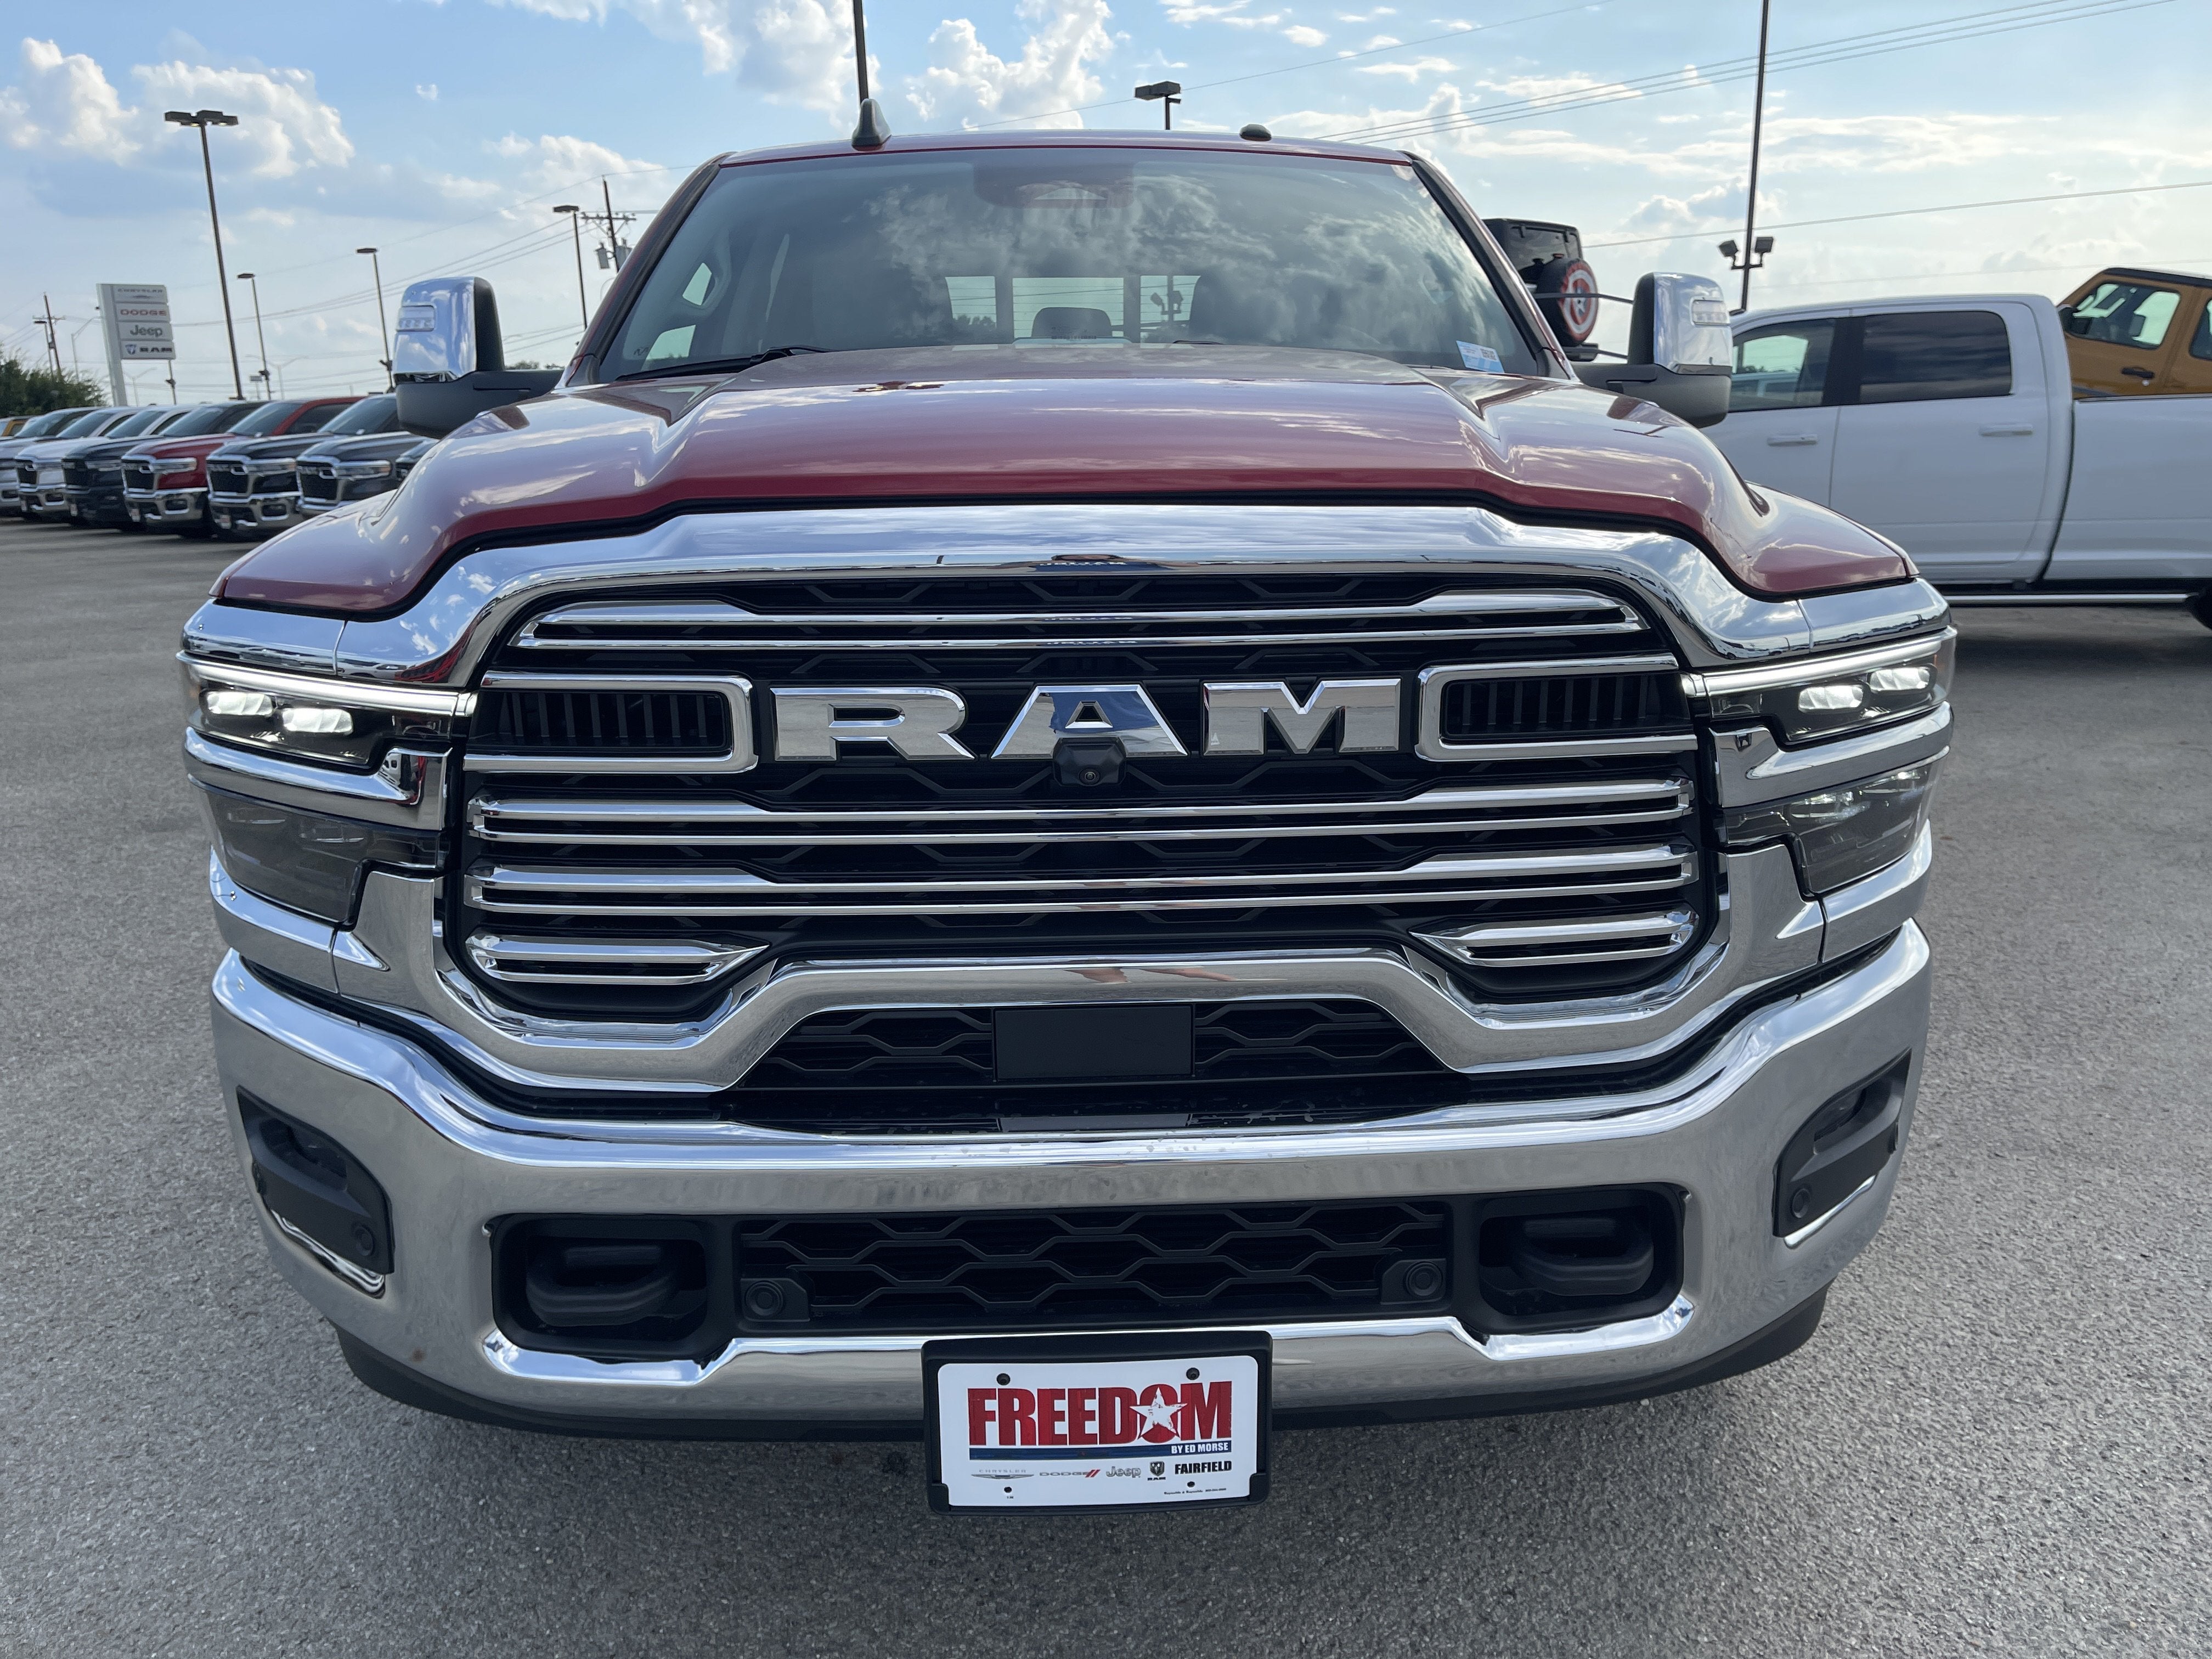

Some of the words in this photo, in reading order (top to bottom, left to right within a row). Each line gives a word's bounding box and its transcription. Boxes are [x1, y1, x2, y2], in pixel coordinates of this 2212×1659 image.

[130, 325, 163, 337] Jeep
[770, 677, 1402, 761] RAM
[967, 1381, 1232, 1446] FREEDOM
[1171, 1445, 1183, 1454] BY
[1184, 1444, 1195, 1453] ED
[1198, 1442, 1229, 1453] MORSE
[1106, 1466, 1141, 1479] Jeep
[1175, 1460, 1232, 1475] FAIRFIELD
